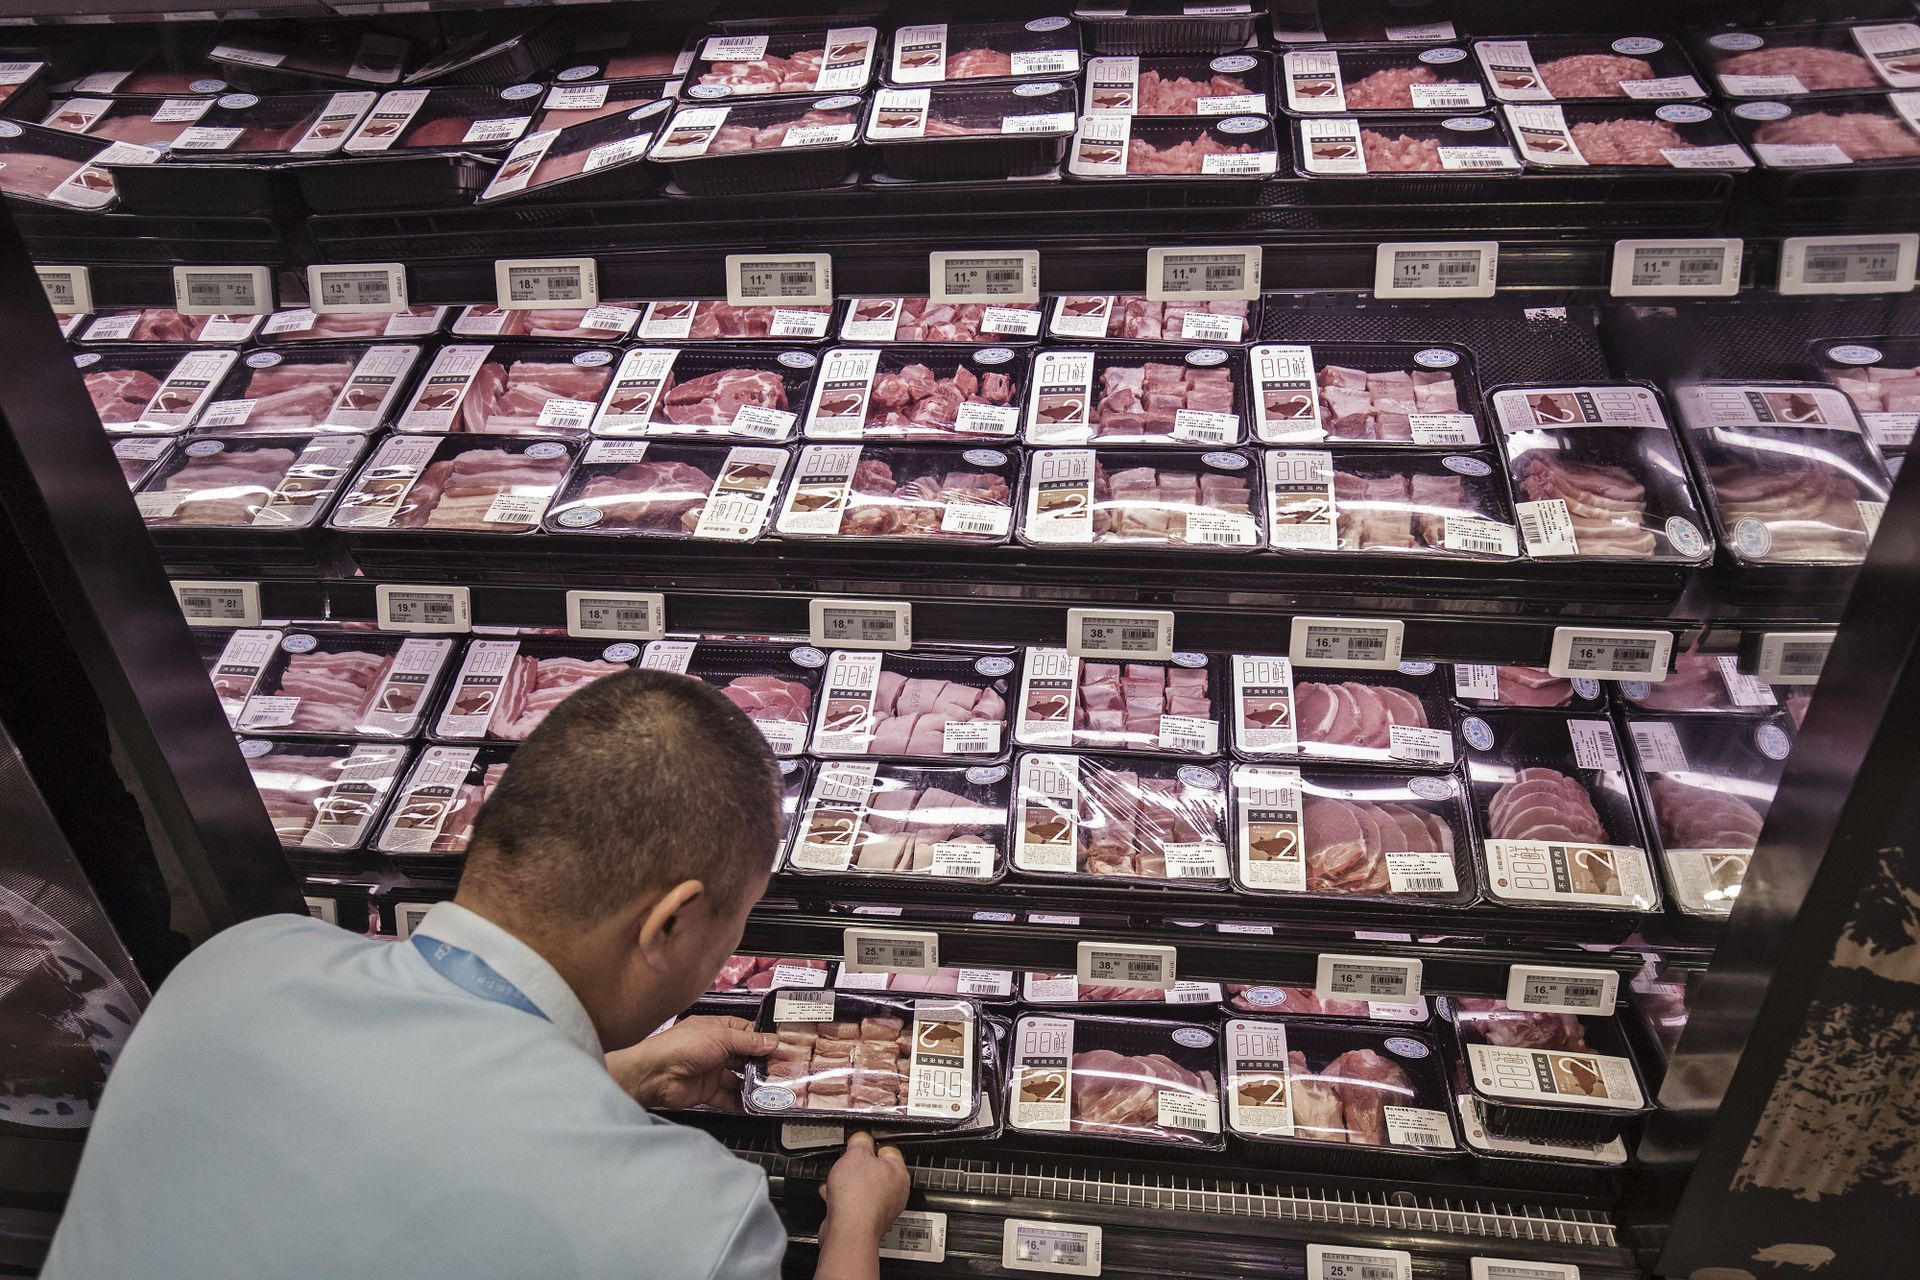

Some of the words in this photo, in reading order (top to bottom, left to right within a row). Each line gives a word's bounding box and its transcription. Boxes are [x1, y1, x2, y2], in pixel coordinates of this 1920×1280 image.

[954, 271, 977, 282] 11.80
[1173, 268, 1197, 279] 11.80
[1403, 263, 1429, 275] 11.80
[1643, 261, 1670, 273] 11.80
[750, 273, 772, 285] 11.80
[1316, 637, 1340, 648] 16.80
[1580, 649, 1604, 659] 16.80
[1243, 661, 1286, 684] 日日鲜
[1268, 702, 1290, 728] 2
[1275, 829, 1297, 860] 2
[1575, 850, 1614, 870] 2
[1340, 973, 1362, 983] 16.80
[1533, 985, 1556, 995] 16.80
[918, 1022, 939, 1047] 2
[1025, 1031, 1067, 1054] 日日鲜
[1236, 1034, 1280, 1057] 日日鲜
[1558, 1057, 1598, 1077] 2
[1043, 1073, 1065, 1101] 2
[1263, 1079, 1284, 1106] 2
